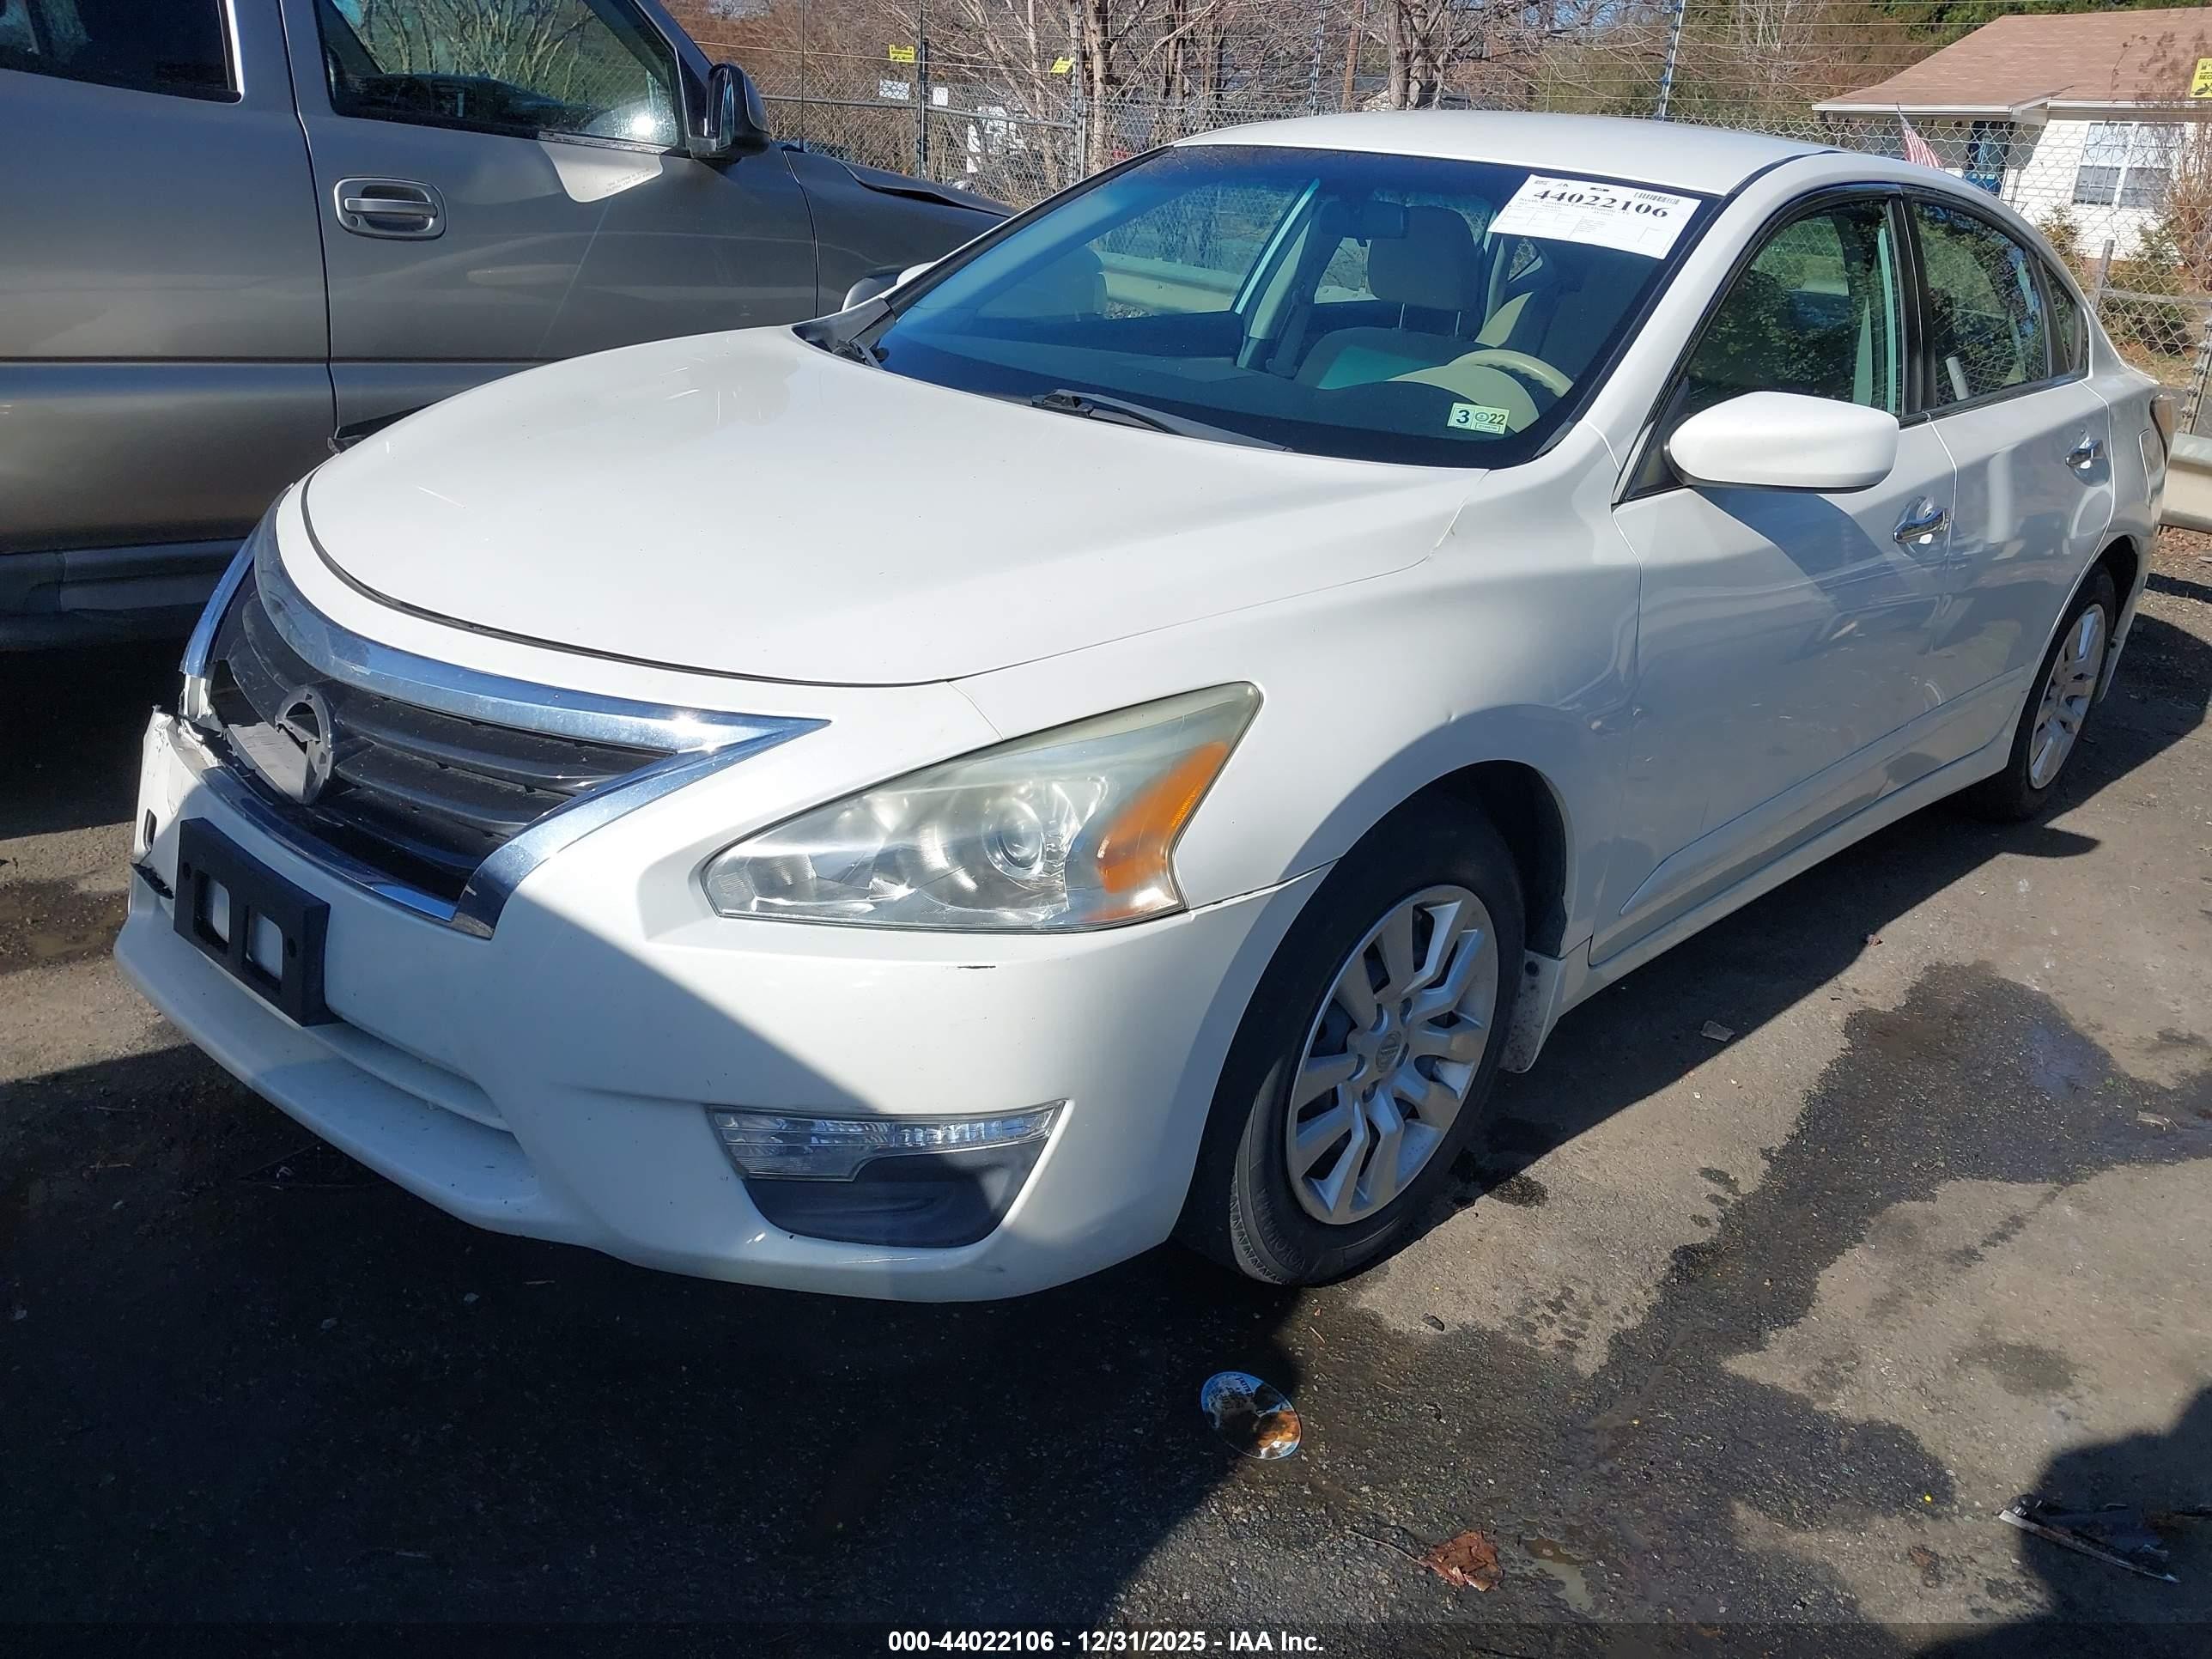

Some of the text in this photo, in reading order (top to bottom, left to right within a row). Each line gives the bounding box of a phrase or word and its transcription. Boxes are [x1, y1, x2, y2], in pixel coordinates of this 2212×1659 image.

[1534, 190, 1669, 218] 44022106
[1455, 410, 1505, 425] 3 22
